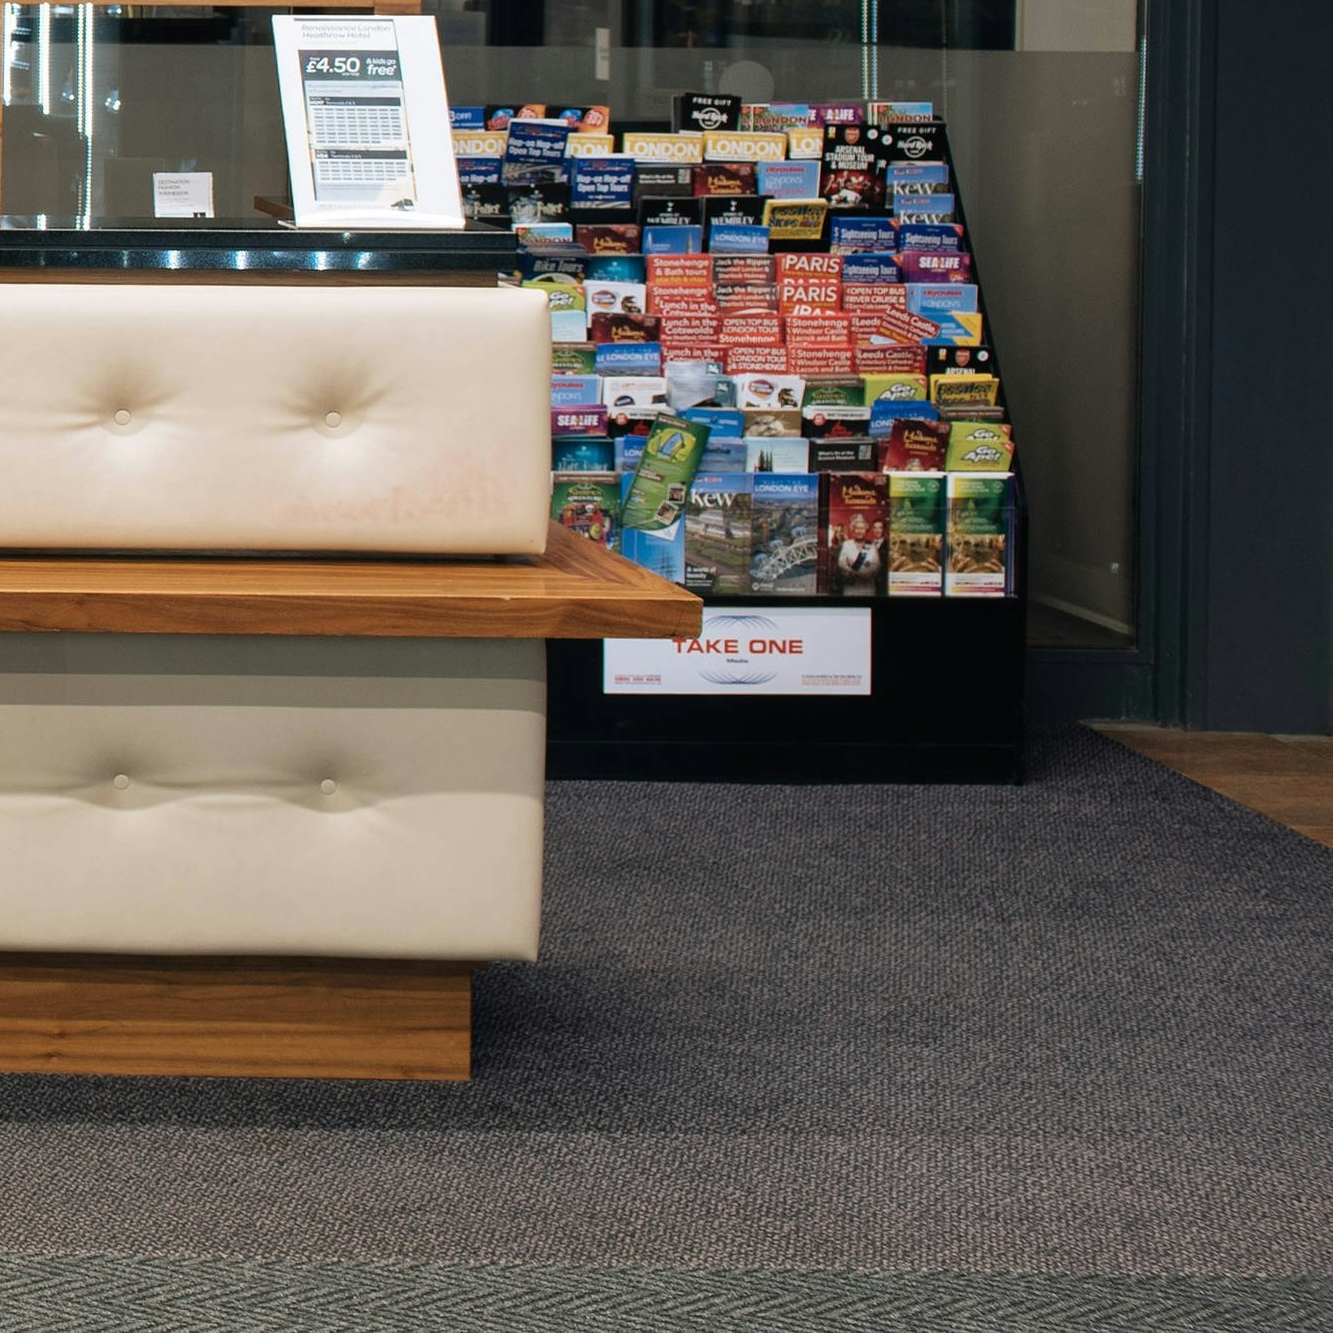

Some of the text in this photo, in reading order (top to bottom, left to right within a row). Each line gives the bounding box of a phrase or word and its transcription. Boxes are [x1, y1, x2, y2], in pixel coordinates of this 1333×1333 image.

[306, 57, 361, 74] £4.50
[692, 96, 732, 107] FREE GIFT
[625, 141, 701, 156] LONDON
[708, 139, 783, 156] LONDON
[835, 146, 866, 154] ARSENAL
[542, 149, 562, 158] Tours
[825, 153, 875, 162] STADIUM TOUR
[838, 162, 868, 170] MUSEUM
[577, 184, 629, 194] Open Top Tours
[653, 258, 709, 268] Stonehenge
[734, 258, 744, 266] the
[746, 259, 771, 267] Ripper
[785, 254, 841, 273] PARIS
[919, 256, 960, 269] SEA LIFE
[664, 268, 683, 276] Bath
[653, 286, 708, 296] Stonehenge
[717, 286, 772, 295] Jack the Ripper
[783, 286, 838, 302] PARIS
[849, 287, 905, 295] OPEN TOP BUS
[870, 296, 897, 304] CRUISE
[660, 302, 716, 311] Lunch in the
[886, 306, 911, 321] Leeds
[661, 318, 718, 327] Lunch in the
[724, 318, 779, 326] OPEN TOP BUS
[793, 318, 848, 328] Stonehenge
[856, 317, 881, 327] Leeds
[665, 326, 714, 335] Cotswolds
[723, 326, 780, 334] LONDON TOUR
[793, 327, 848, 335] Windsor Castle
[663, 348, 719, 357] Lunch in the
[732, 347, 786, 355] OPEN TOP BUS
[796, 349, 852, 359] Stonehenge
[858, 349, 884, 359] Leeds
[733, 355, 787, 363] LONDON TOUR
[739, 363, 787, 371] STONEHENGE
[890, 383, 912, 393] Go
[880, 389, 916, 401] Ape!
[557, 414, 599, 426] SEA LIFE
[871, 419, 894, 428] LOND
[975, 445, 997, 455] Go
[965, 451, 1002, 463] Ape!
[755, 485, 792, 493] LONDON
[673, 639, 804, 654] TAKE ONE
